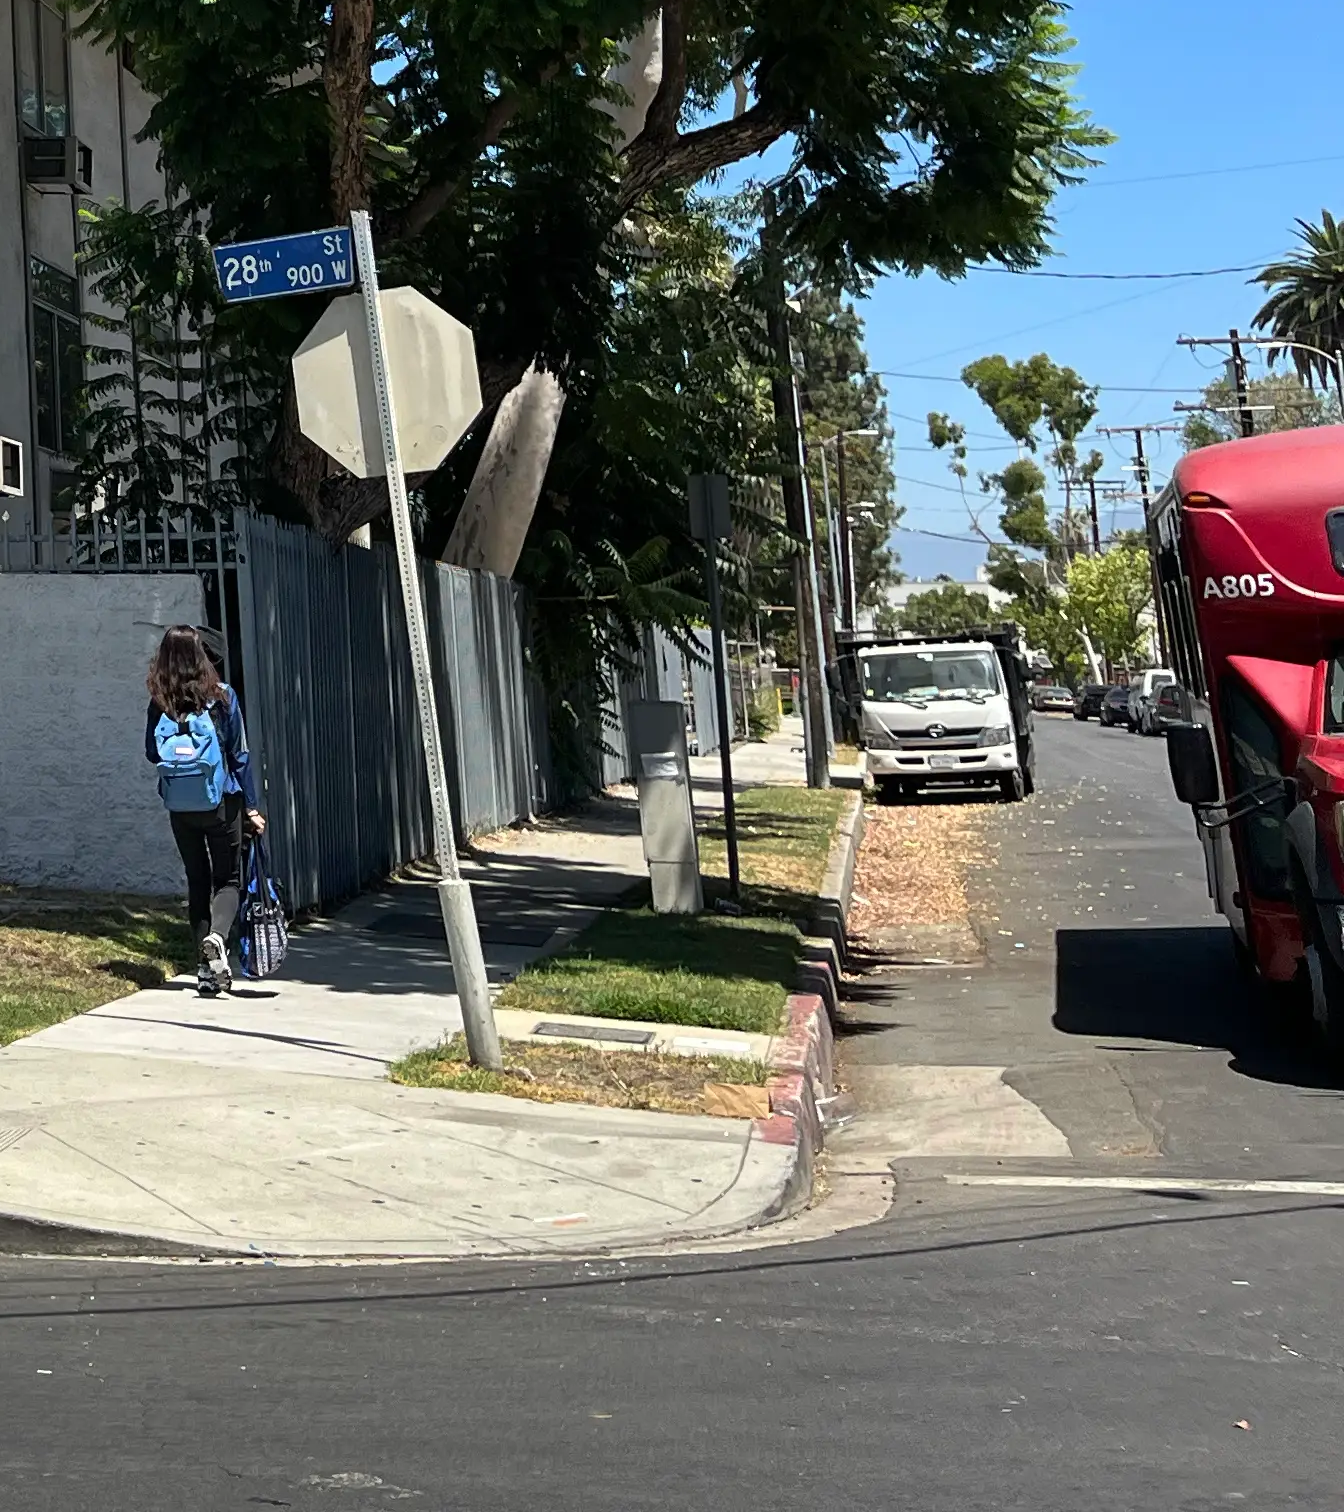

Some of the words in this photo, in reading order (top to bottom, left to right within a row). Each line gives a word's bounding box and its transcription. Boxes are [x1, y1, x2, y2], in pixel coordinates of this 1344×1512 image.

[223, 254, 273, 290] 28th
[323, 235, 344, 256] St
[286, 263, 324, 287] 900
[331, 259, 348, 281] W
[1203, 573, 1276, 599] A805
